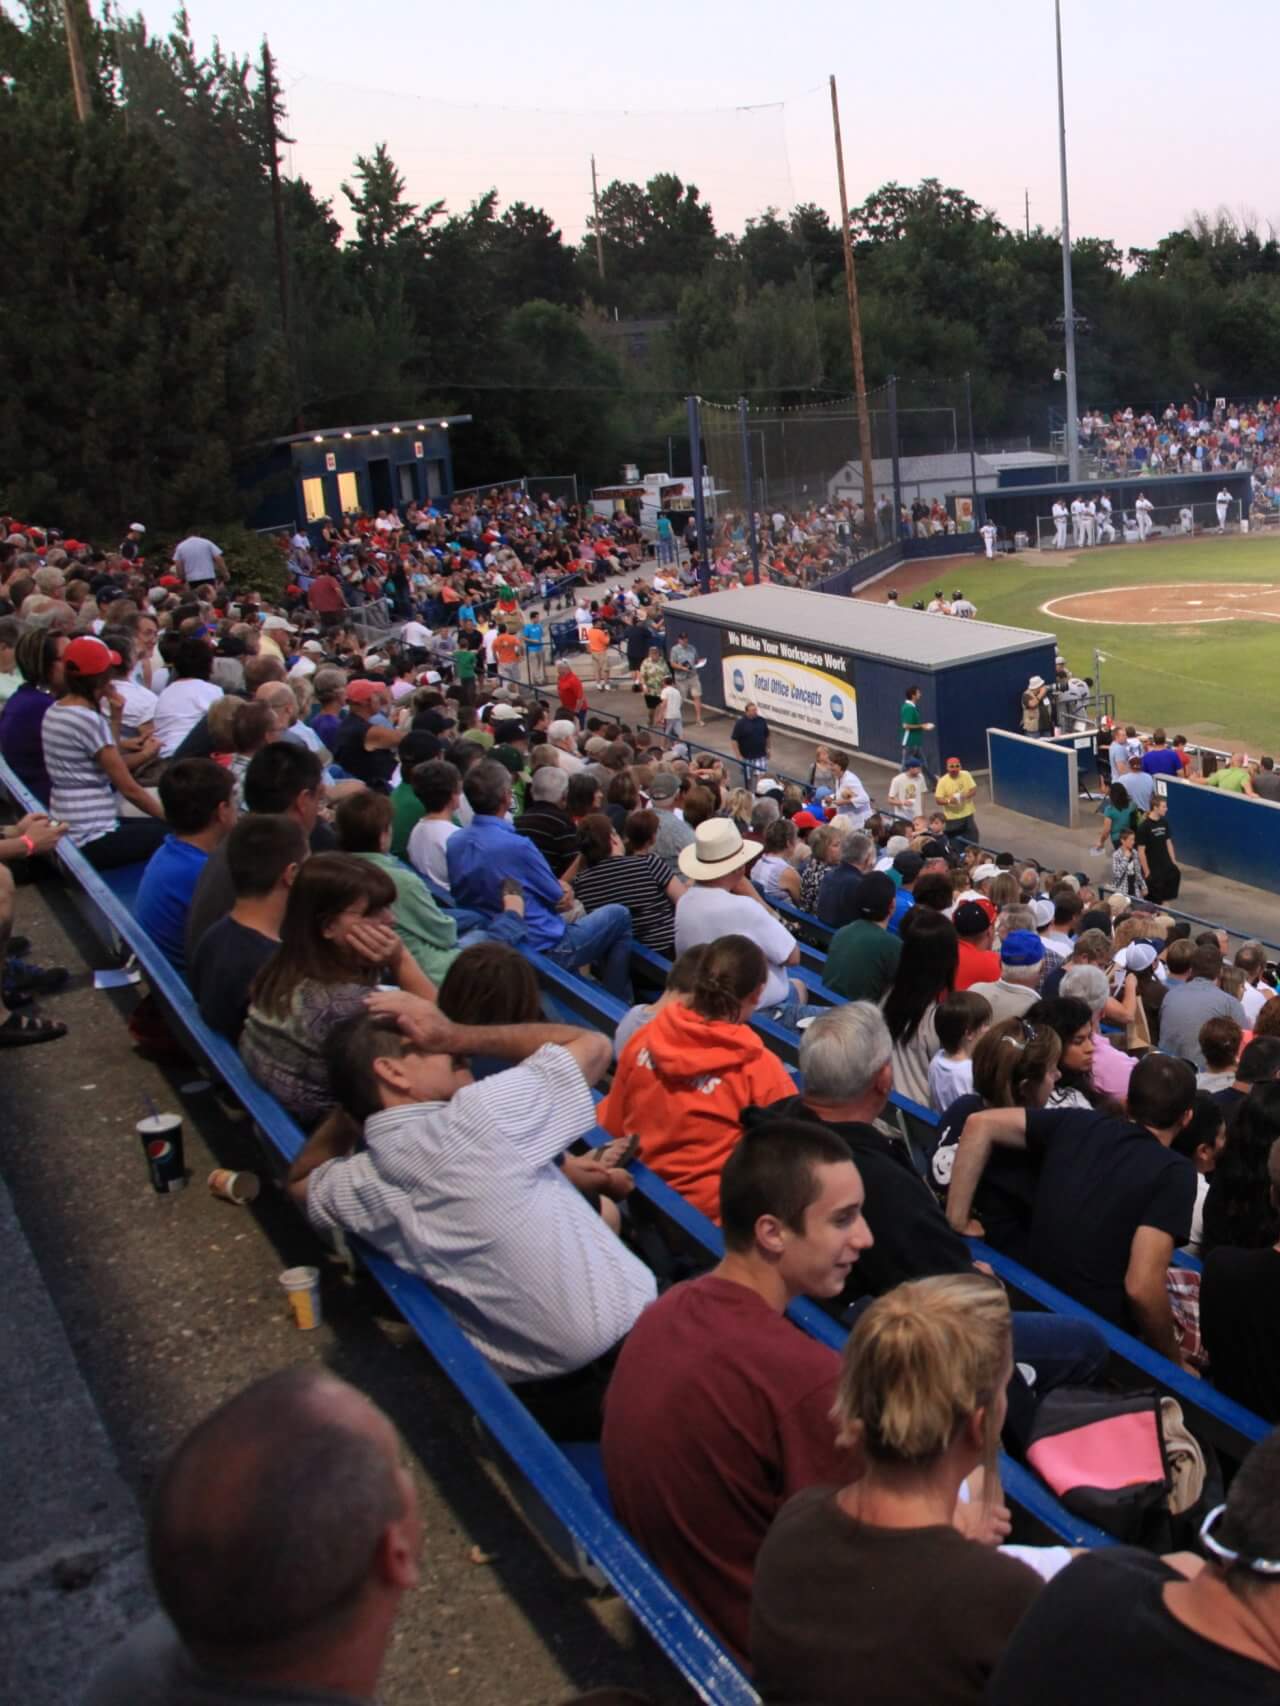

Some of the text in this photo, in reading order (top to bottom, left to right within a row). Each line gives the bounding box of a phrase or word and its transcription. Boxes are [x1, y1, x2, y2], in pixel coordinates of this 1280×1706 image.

[728, 631, 847, 672] We Make Your Workspace Work
[754, 674, 822, 707] Total Office Concepts
